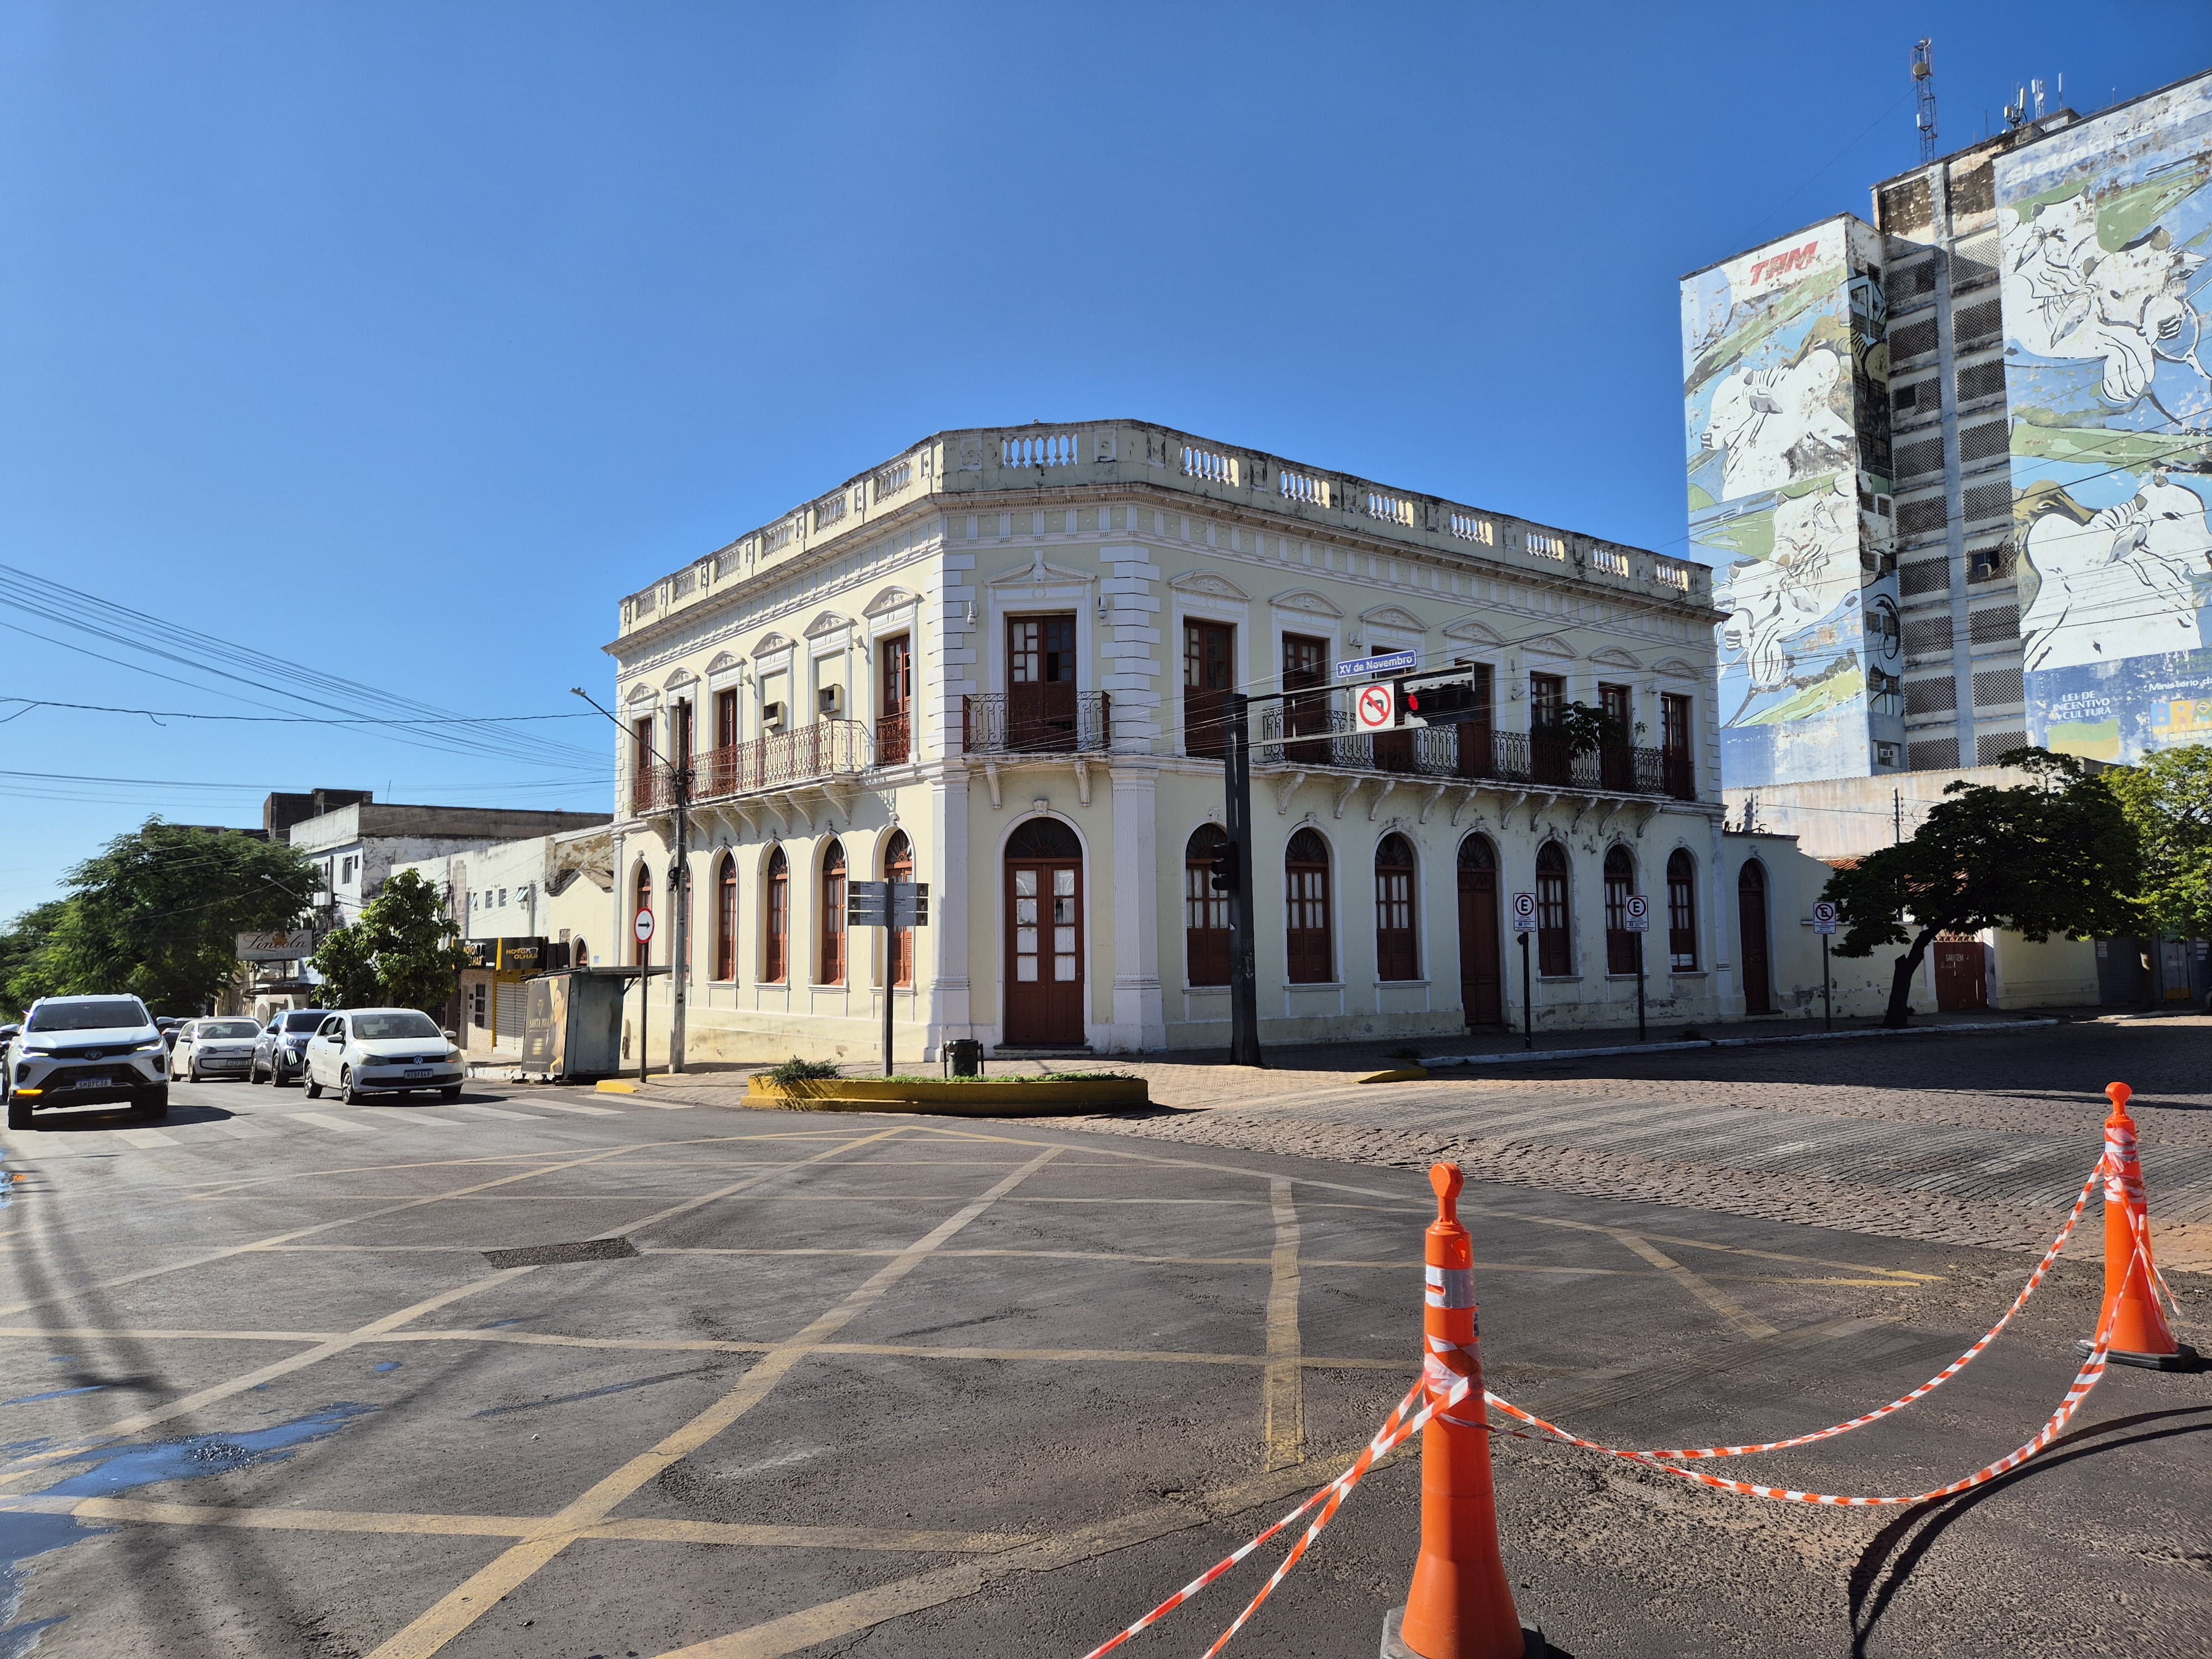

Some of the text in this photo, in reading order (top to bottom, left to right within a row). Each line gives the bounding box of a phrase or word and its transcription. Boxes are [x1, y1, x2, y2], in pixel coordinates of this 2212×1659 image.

[1750, 241, 1818, 286] TAM
[1339, 656, 1413, 674] XV de Novembro
[2062, 690, 2096, 702] LEI DE
[2053, 698, 2110, 711] INCENTIVO
[2063, 707, 2111, 719] CULTURA
[1521, 899, 1528, 911] E
[1633, 901, 1640, 913] E
[243, 933, 306, 952] Lincoln
[469, 956, 482, 966] HAR
[530, 1018, 541, 1027] SANTA
